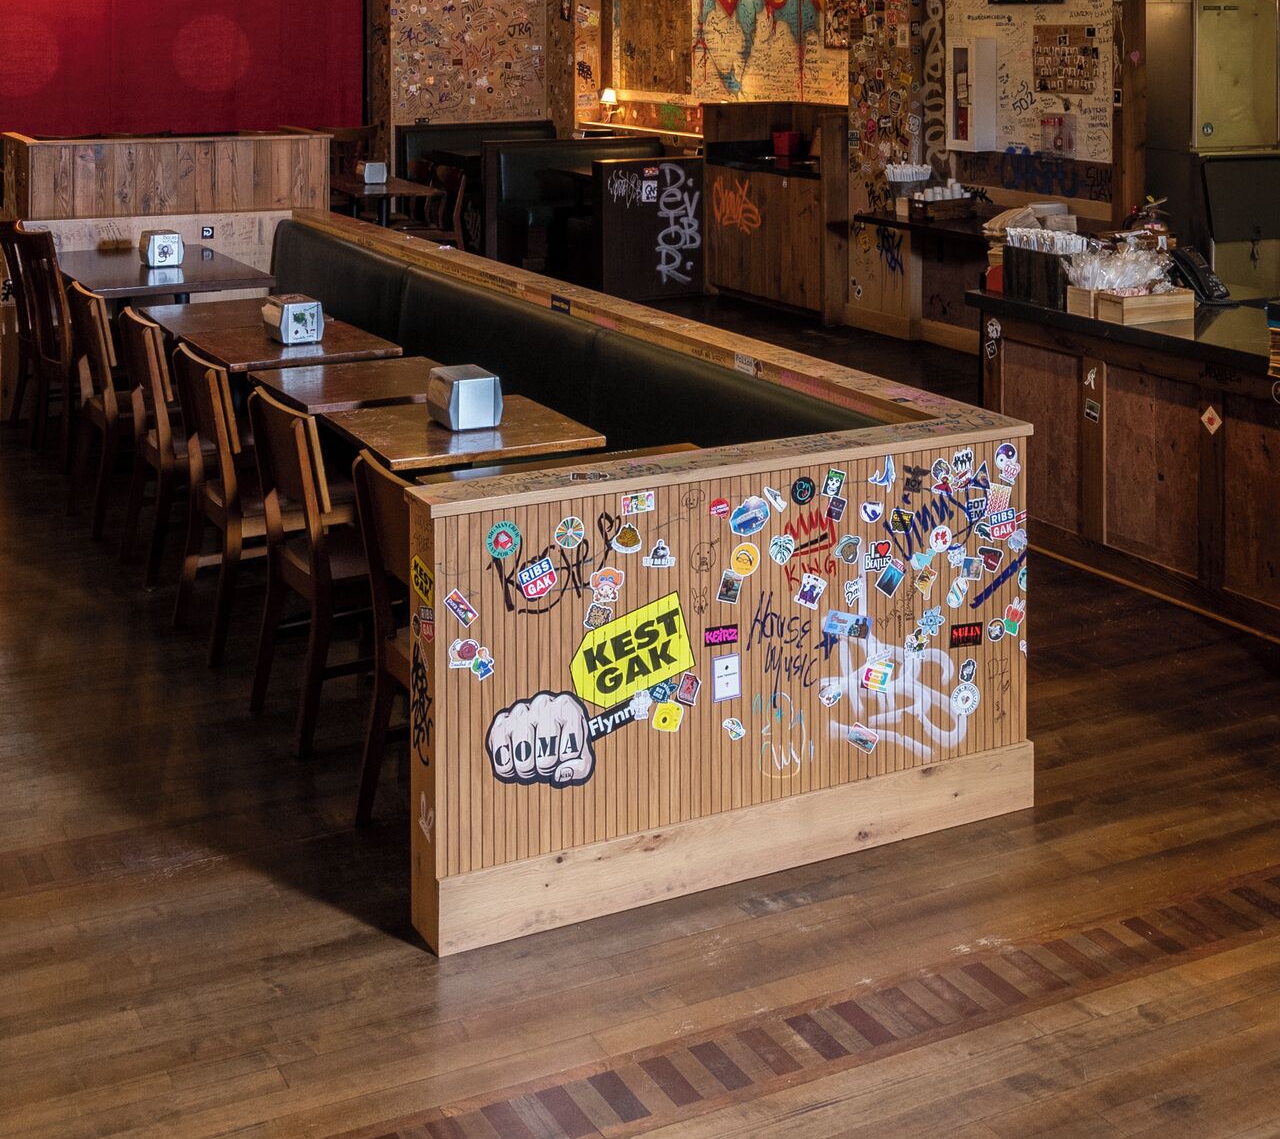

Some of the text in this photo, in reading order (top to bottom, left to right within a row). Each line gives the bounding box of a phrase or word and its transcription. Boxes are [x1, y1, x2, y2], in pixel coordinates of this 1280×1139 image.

[905, 480, 921, 489] BOY
[968, 499, 985, 511] GOT
[992, 510, 1015, 523] RIBS
[993, 524, 1014, 537] GAK
[865, 552, 891, 570] BEATLES
[412, 559, 434, 588] KEST
[521, 561, 549, 583] RIBS
[527, 576, 553, 596] GAK
[583, 609, 680, 673] KEST
[596, 639, 677, 694] GAK
[590, 704, 636, 738] Flynn
[494, 732, 578, 767] COMA
